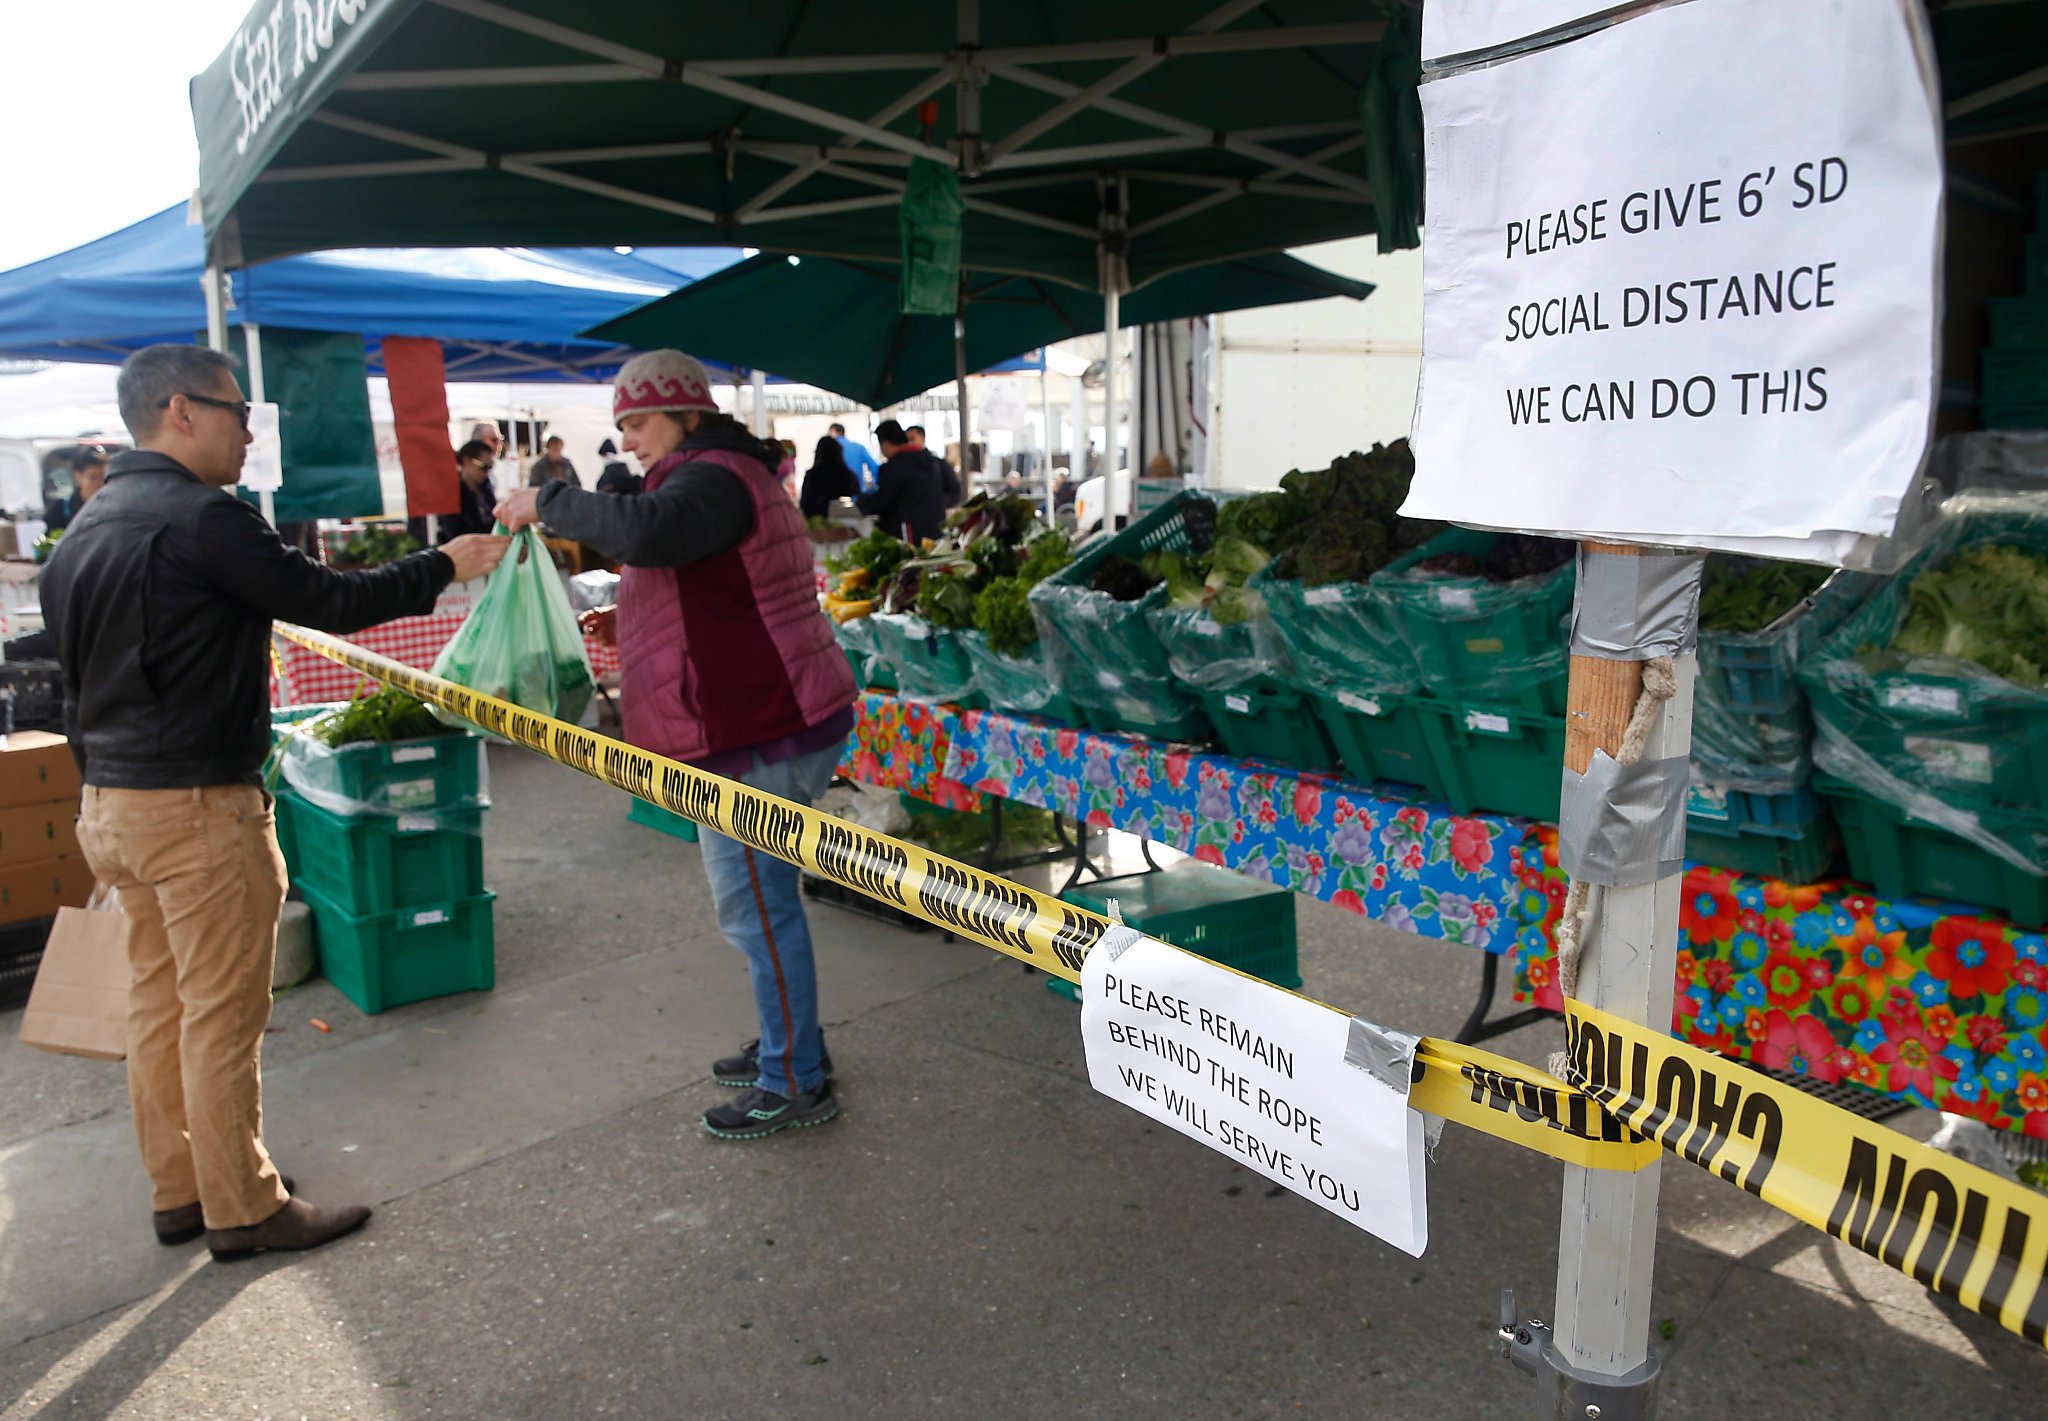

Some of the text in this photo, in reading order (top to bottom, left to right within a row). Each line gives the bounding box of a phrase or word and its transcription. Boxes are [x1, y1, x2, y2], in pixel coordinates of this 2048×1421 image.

[229, 0, 283, 155] Star
[1506, 199, 1608, 259] PLEASE
[1620, 179, 1722, 234] GIVE
[1792, 156, 1848, 209] SD
[1505, 262, 1837, 342] SOCIAL DISTANCE
[1506, 366, 1828, 425] WE CAN DO THIS
[604, 745, 658, 804] CAUTION
[662, 765, 725, 833] CAUTION
[731, 790, 806, 867] CAUTION
[815, 820, 908, 907] CAUTION
[918, 858, 1037, 954] CAUTION
[1104, 973, 1294, 1080] PLEASE REMAIN
[1108, 1020, 1324, 1147] BEHIND THE ROPE
[1117, 1064, 1361, 1213] WE WILL SERVE YOU
